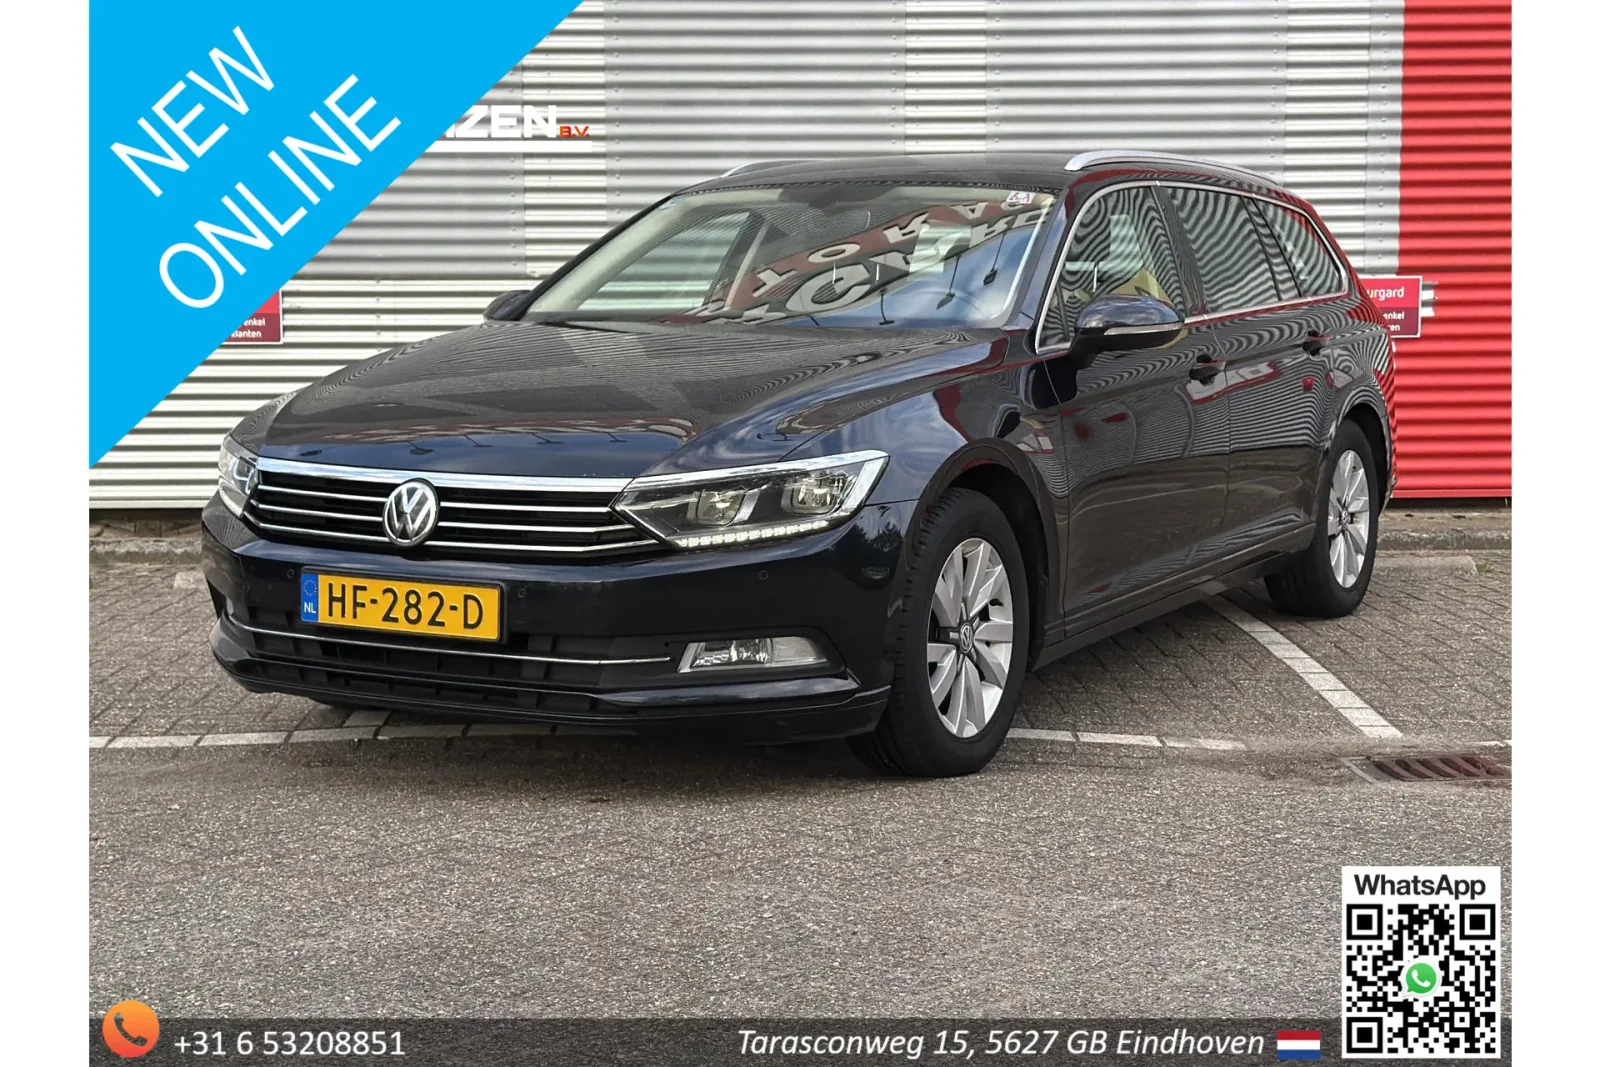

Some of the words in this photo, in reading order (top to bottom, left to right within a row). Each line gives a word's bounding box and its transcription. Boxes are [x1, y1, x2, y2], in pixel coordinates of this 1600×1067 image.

[445, 104, 557, 138] ZEN
[559, 125, 591, 138] B.V.
[304, 602, 317, 614] NL
[328, 582, 484, 630] HF-282-D
